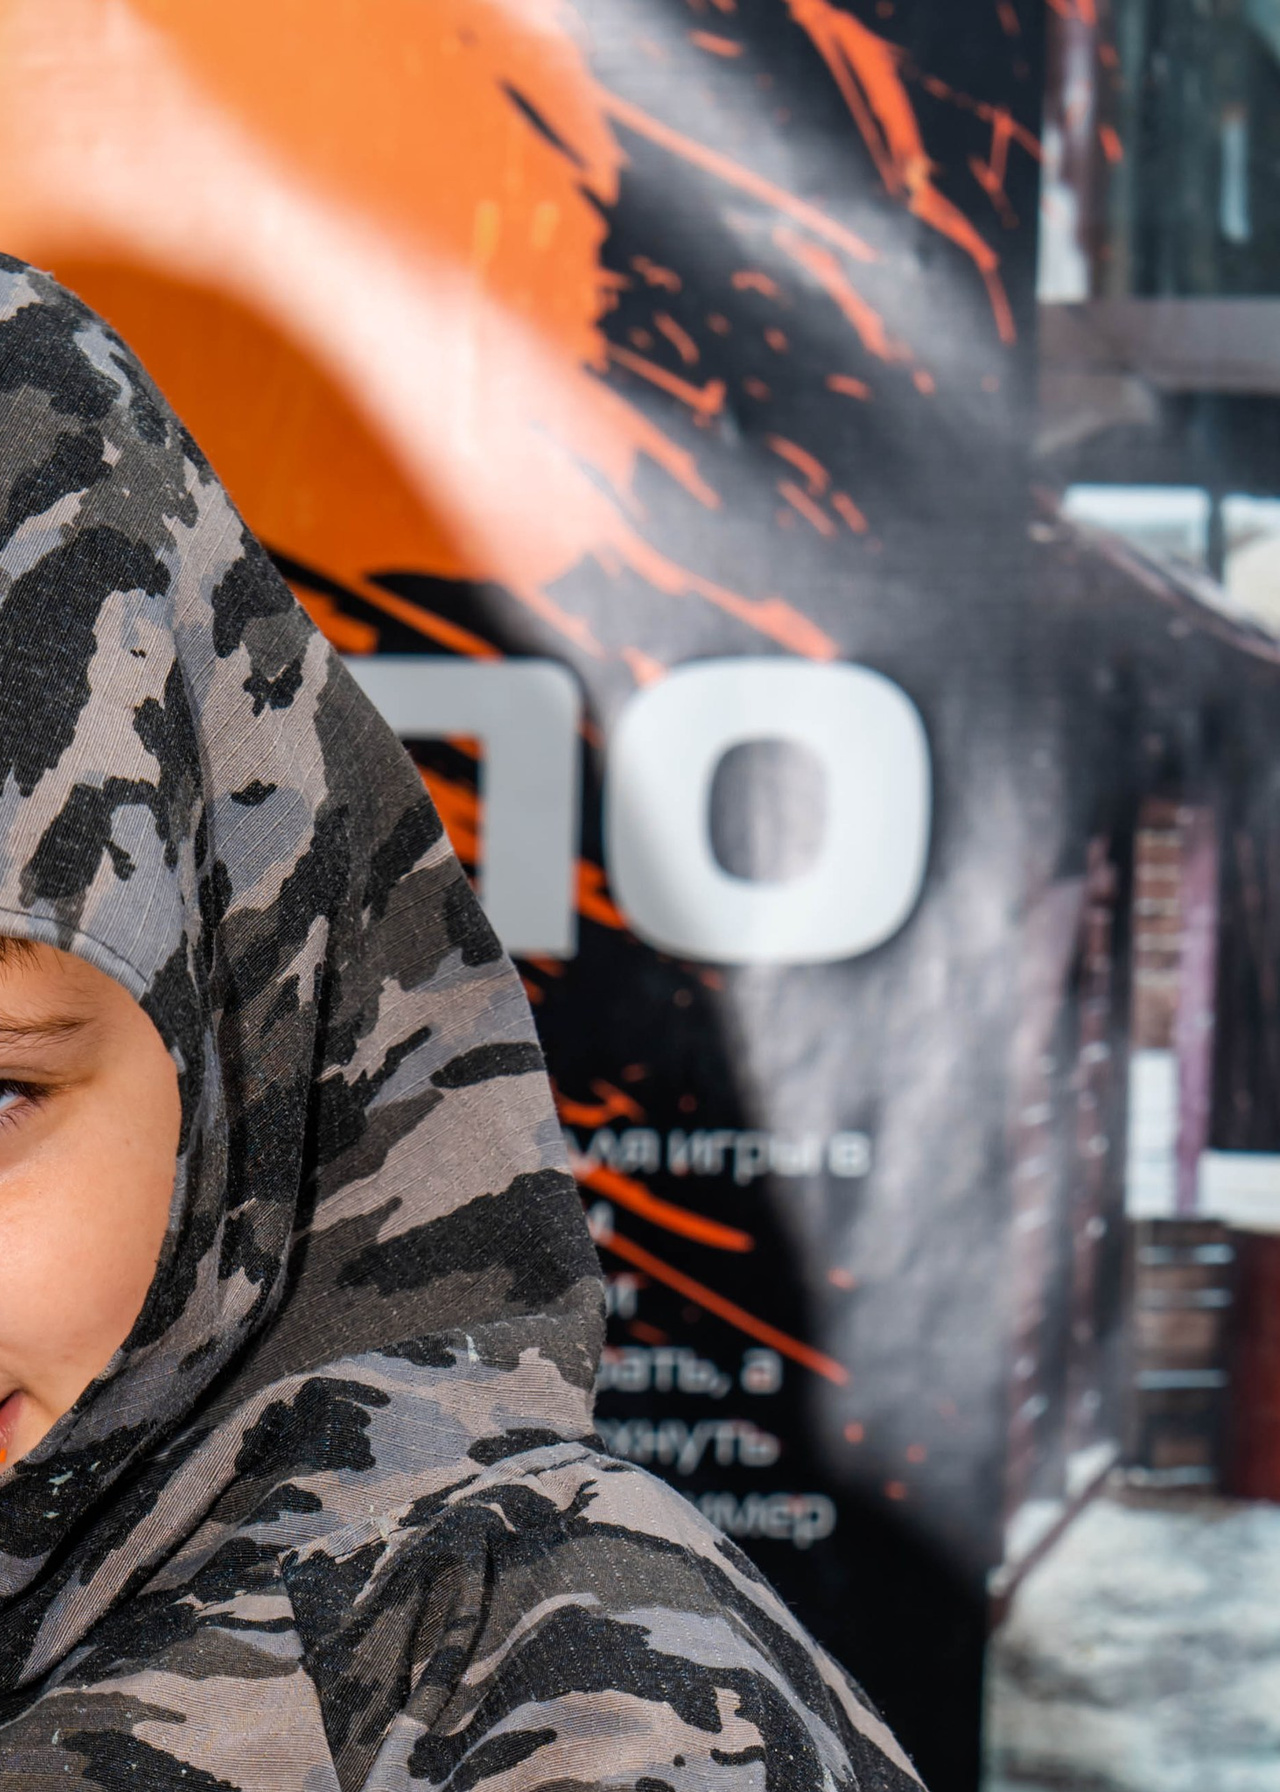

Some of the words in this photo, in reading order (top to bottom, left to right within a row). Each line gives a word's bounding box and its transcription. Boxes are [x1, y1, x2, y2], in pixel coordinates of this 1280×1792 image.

[667, 1128, 824, 1186] игры
[827, 1130, 871, 1178] в
[742, 1349, 782, 1394] а
